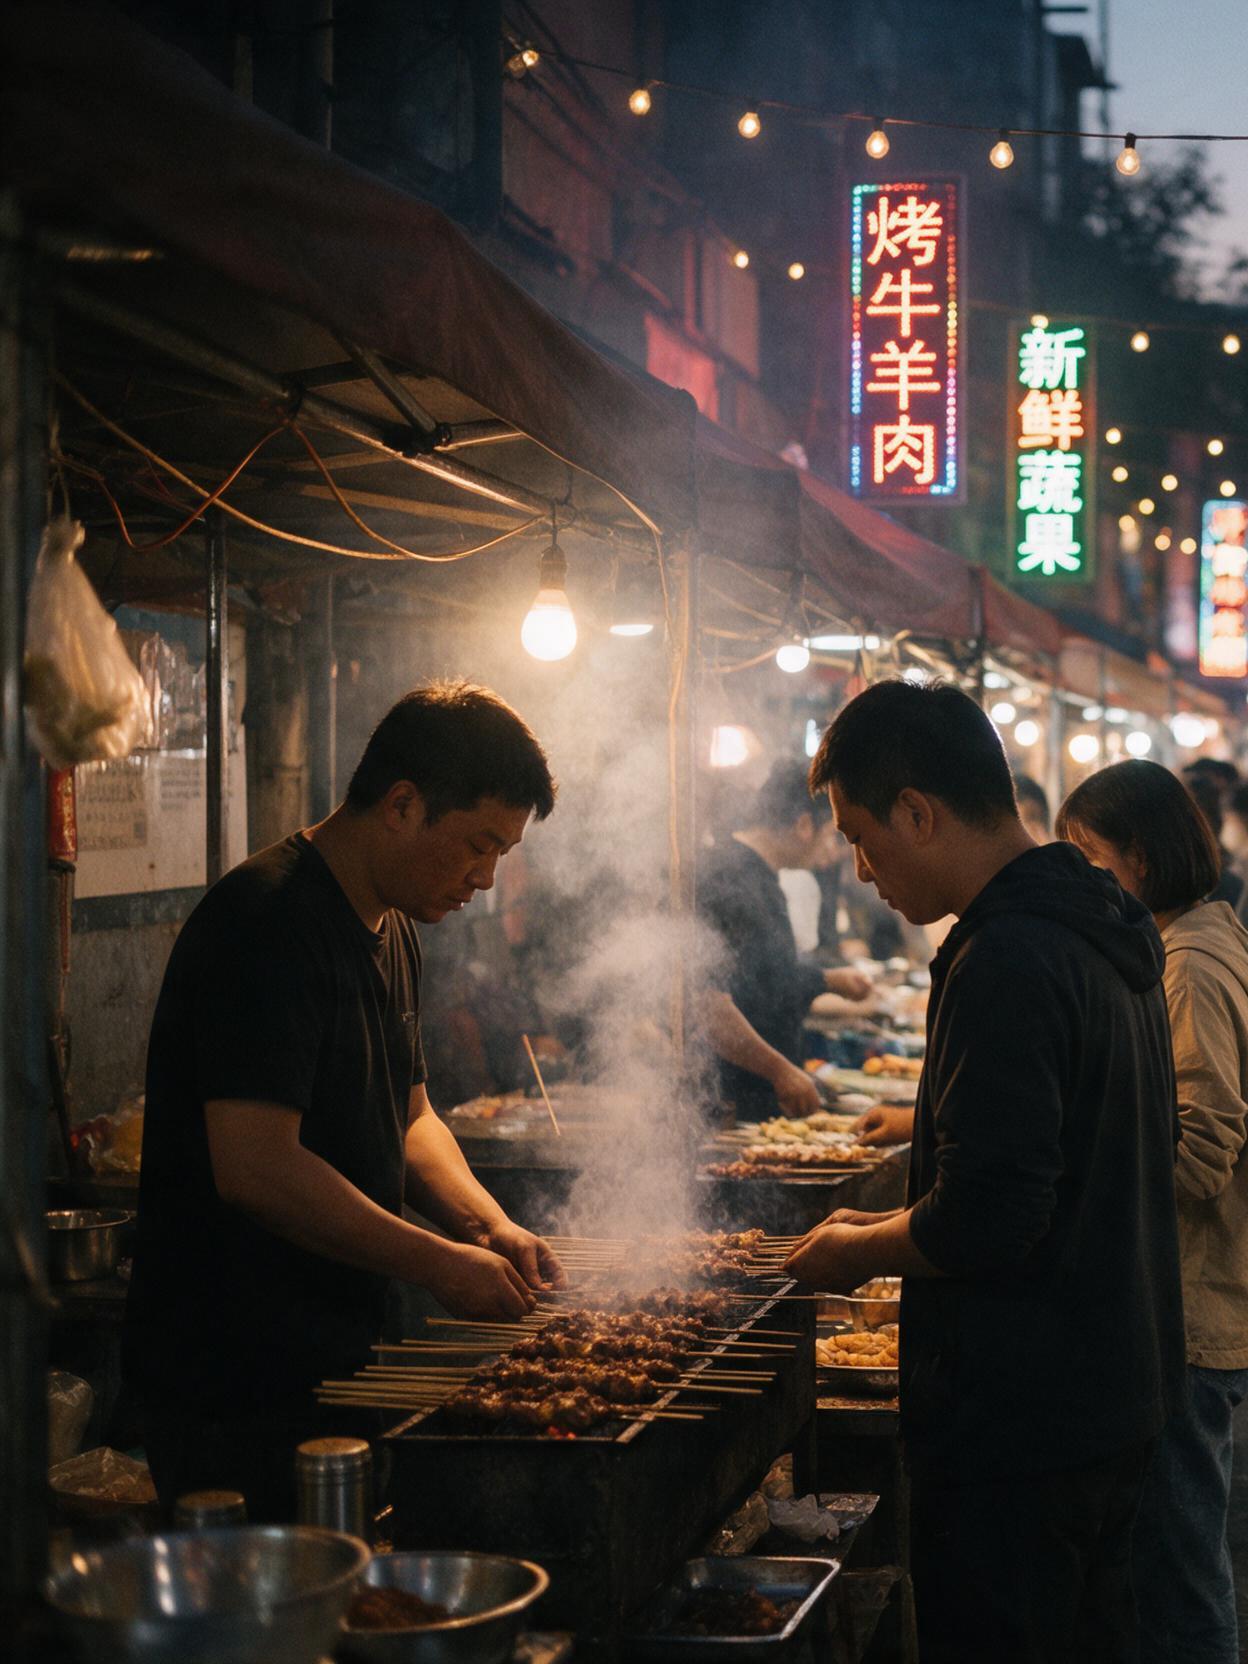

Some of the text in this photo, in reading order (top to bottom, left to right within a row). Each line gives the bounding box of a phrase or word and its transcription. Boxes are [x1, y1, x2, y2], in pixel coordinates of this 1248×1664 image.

[866, 196, 943, 485] 烤牛羊肉
[1017, 326, 1085, 575] 新鲜蔬果
